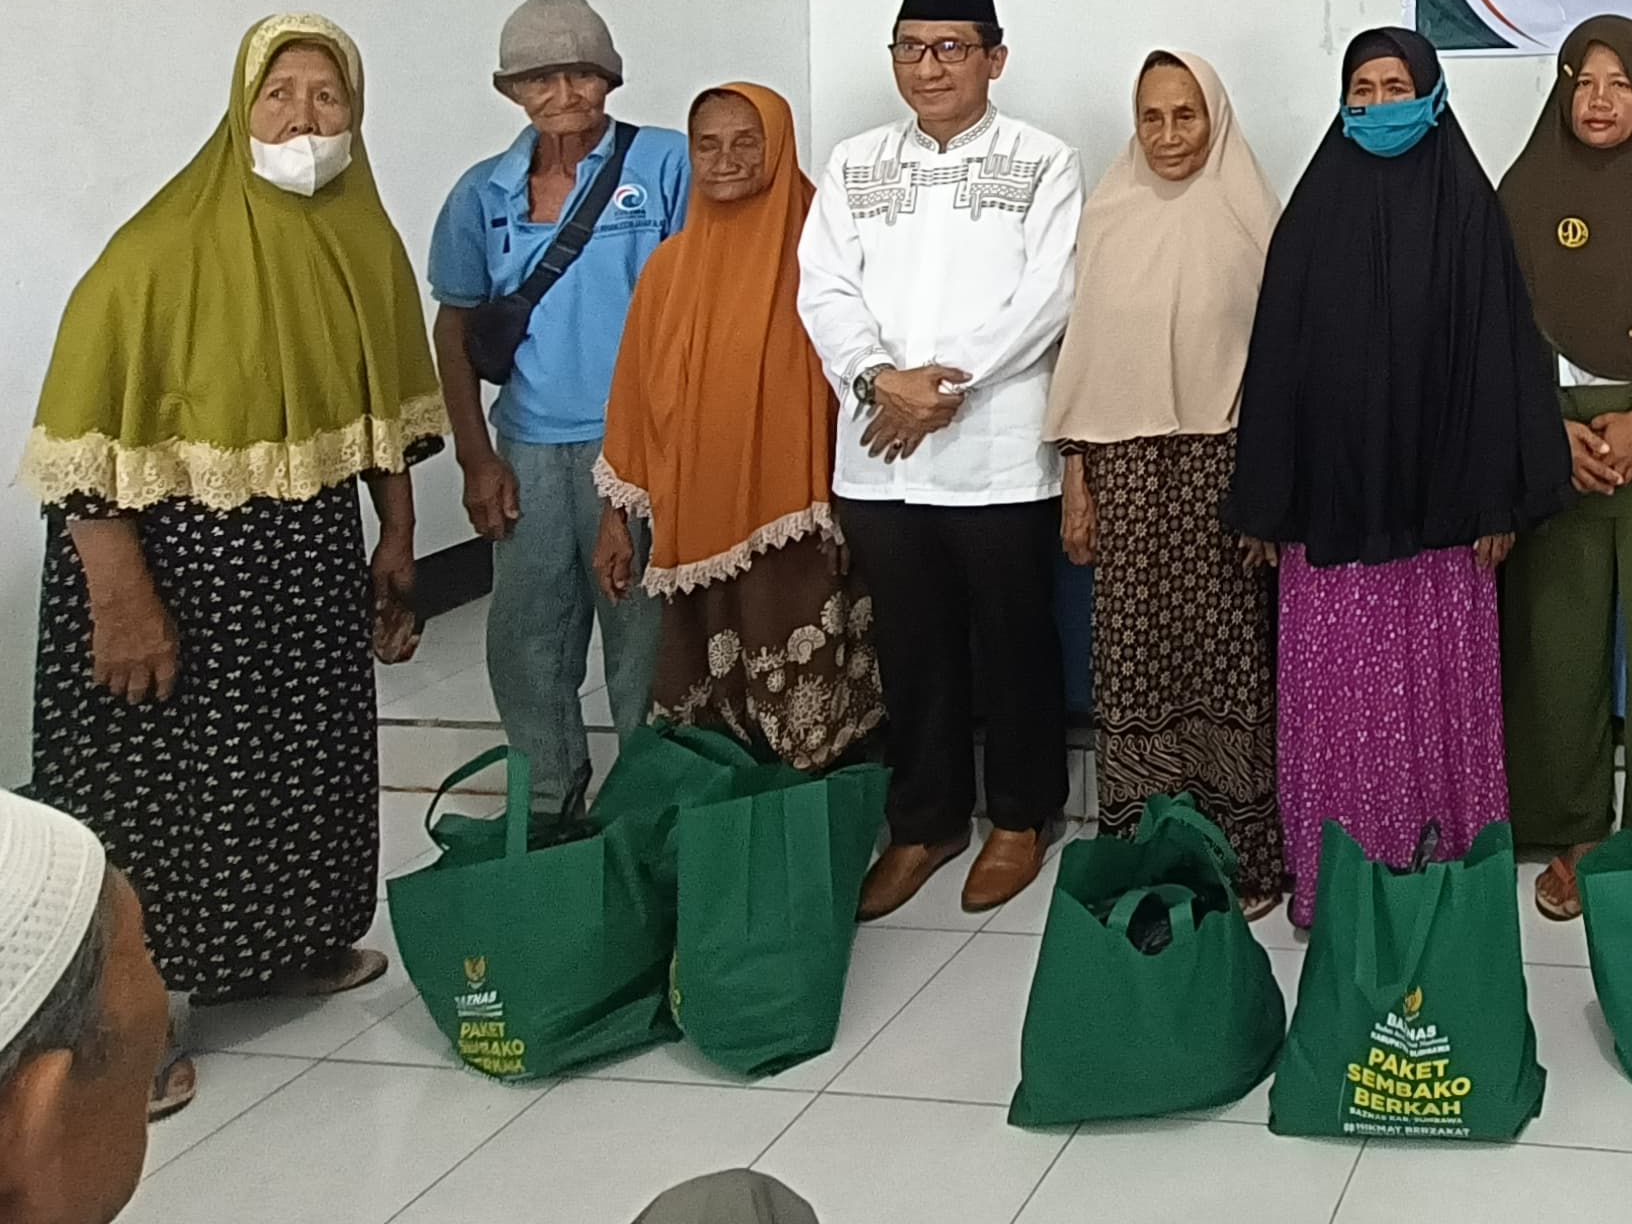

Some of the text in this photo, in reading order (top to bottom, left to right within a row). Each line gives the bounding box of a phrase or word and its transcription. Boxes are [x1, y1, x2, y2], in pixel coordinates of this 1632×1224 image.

[460, 1021, 506, 1039] PAKET
[1368, 1047, 1450, 1081] PAKET
[1347, 1063, 1472, 1100] SEMBAKO
[1353, 1086, 1462, 1116] BERKAH
